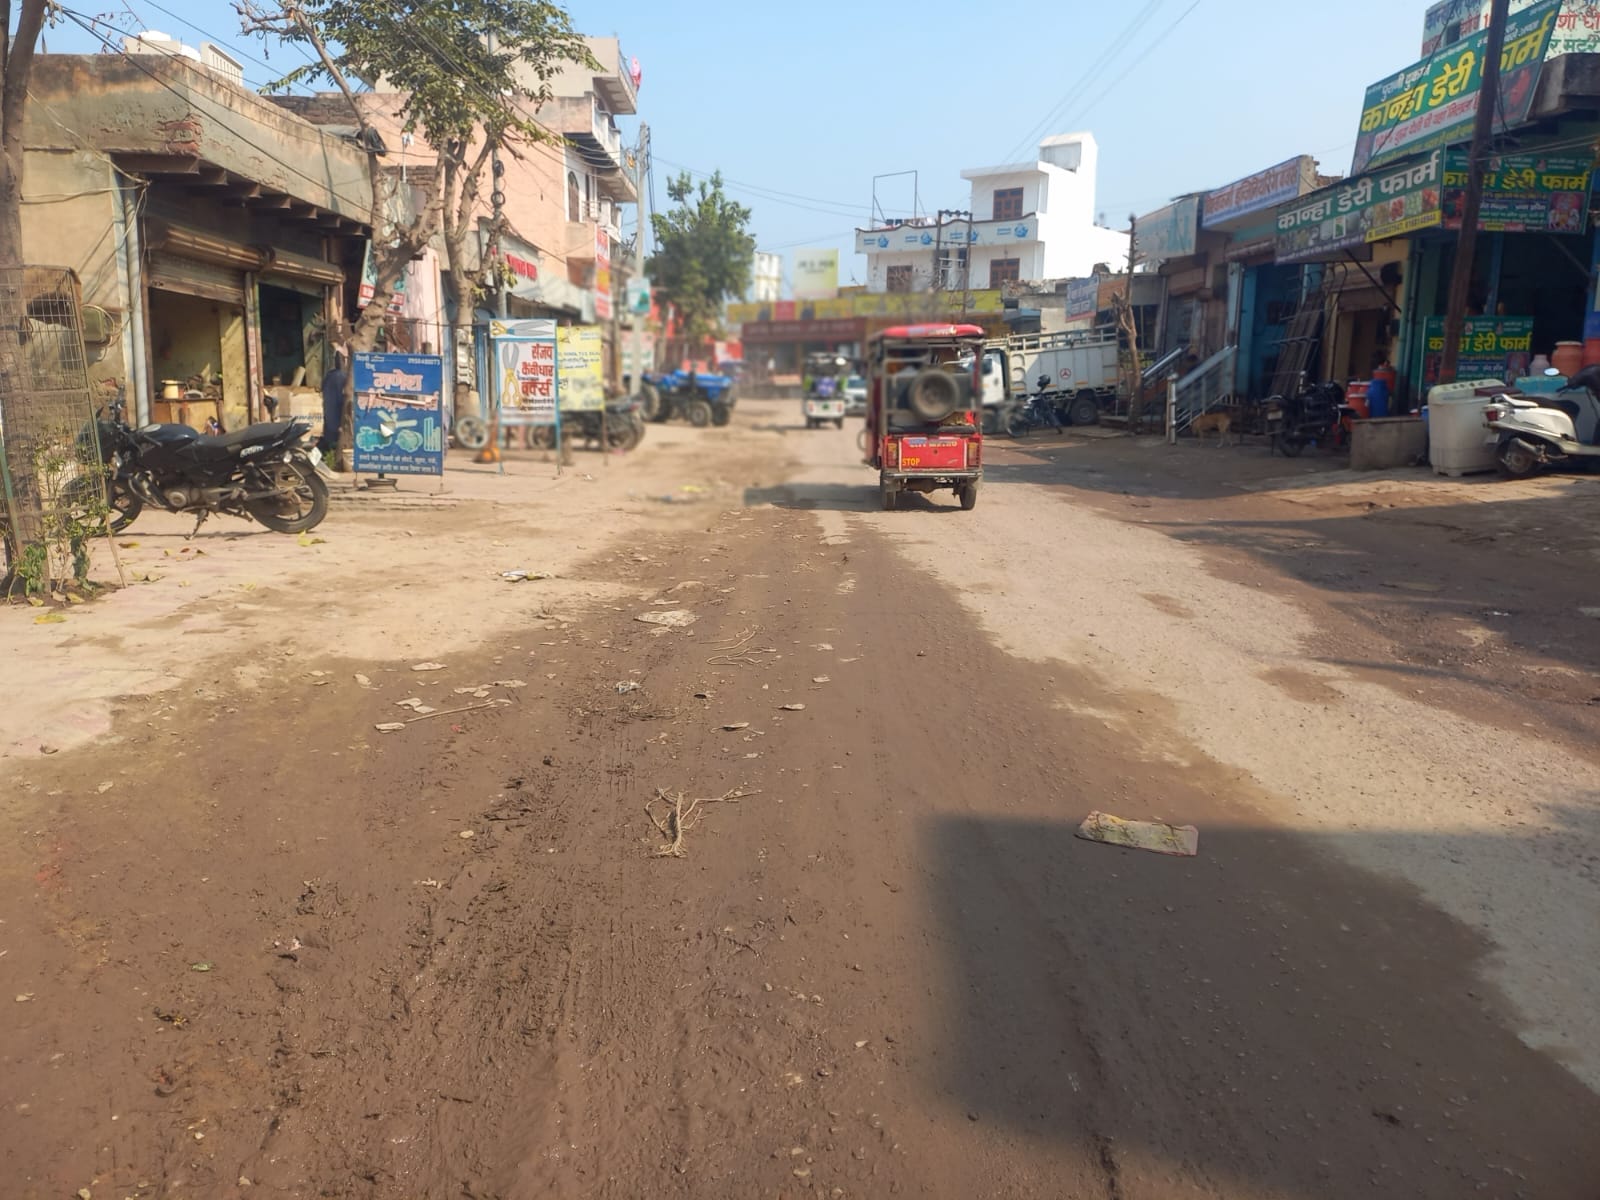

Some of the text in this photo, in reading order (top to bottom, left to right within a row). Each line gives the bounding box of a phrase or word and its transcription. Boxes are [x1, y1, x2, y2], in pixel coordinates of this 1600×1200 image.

[1361, 83, 1428, 132] कान्हा
[1429, 50, 1476, 106] डेरी
[1501, 168, 1536, 189] डेरी
[1542, 171, 1590, 190] फार्म
[1278, 199, 1333, 231] कान्हा
[1337, 177, 1374, 213] डेरी
[1380, 150, 1441, 195] फार्म
[1473, 332, 1496, 351] डेरी
[1500, 331, 1532, 350] फार्म
[902, 457, 921, 466] STOP
